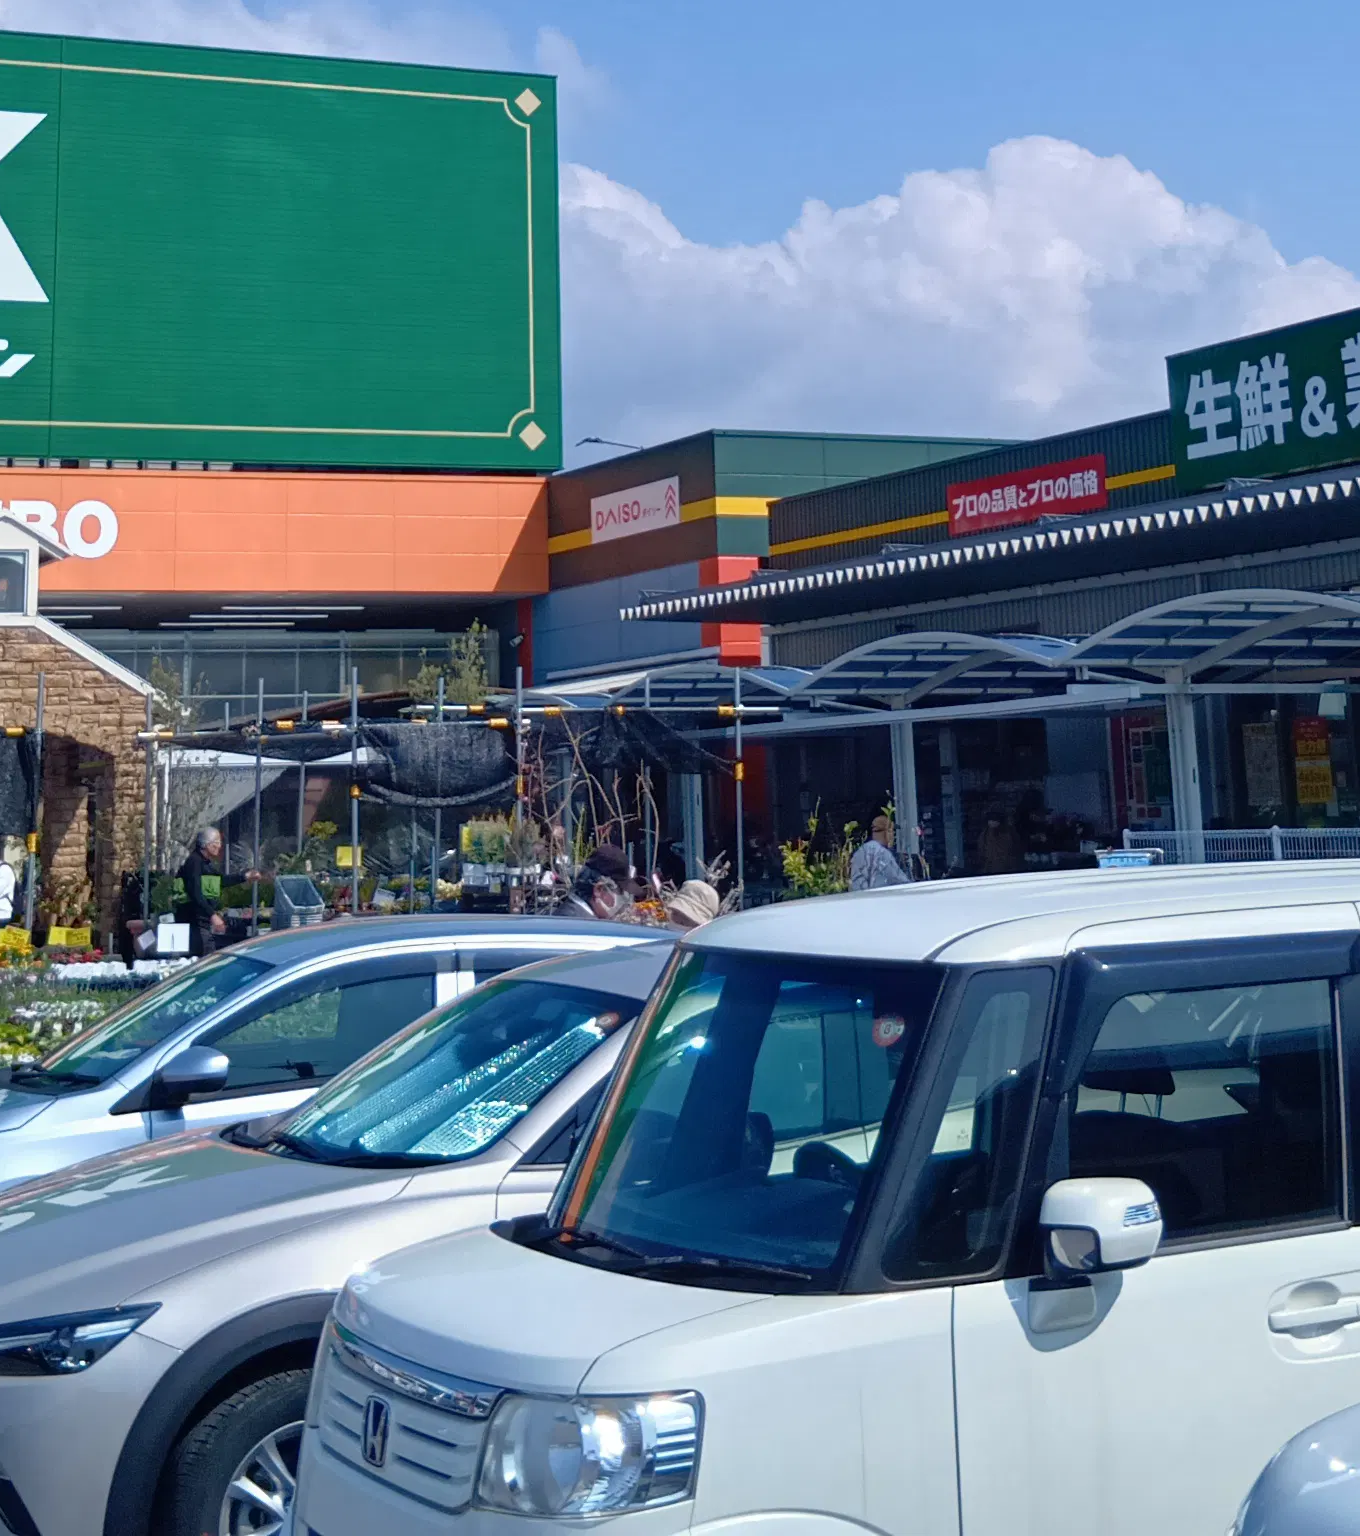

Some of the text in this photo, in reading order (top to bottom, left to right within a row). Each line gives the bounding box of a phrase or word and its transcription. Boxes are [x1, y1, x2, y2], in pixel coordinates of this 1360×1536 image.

[595, 499, 641, 531] DAISO
[951, 469, 1099, 520] プロの品質とプロの価格
